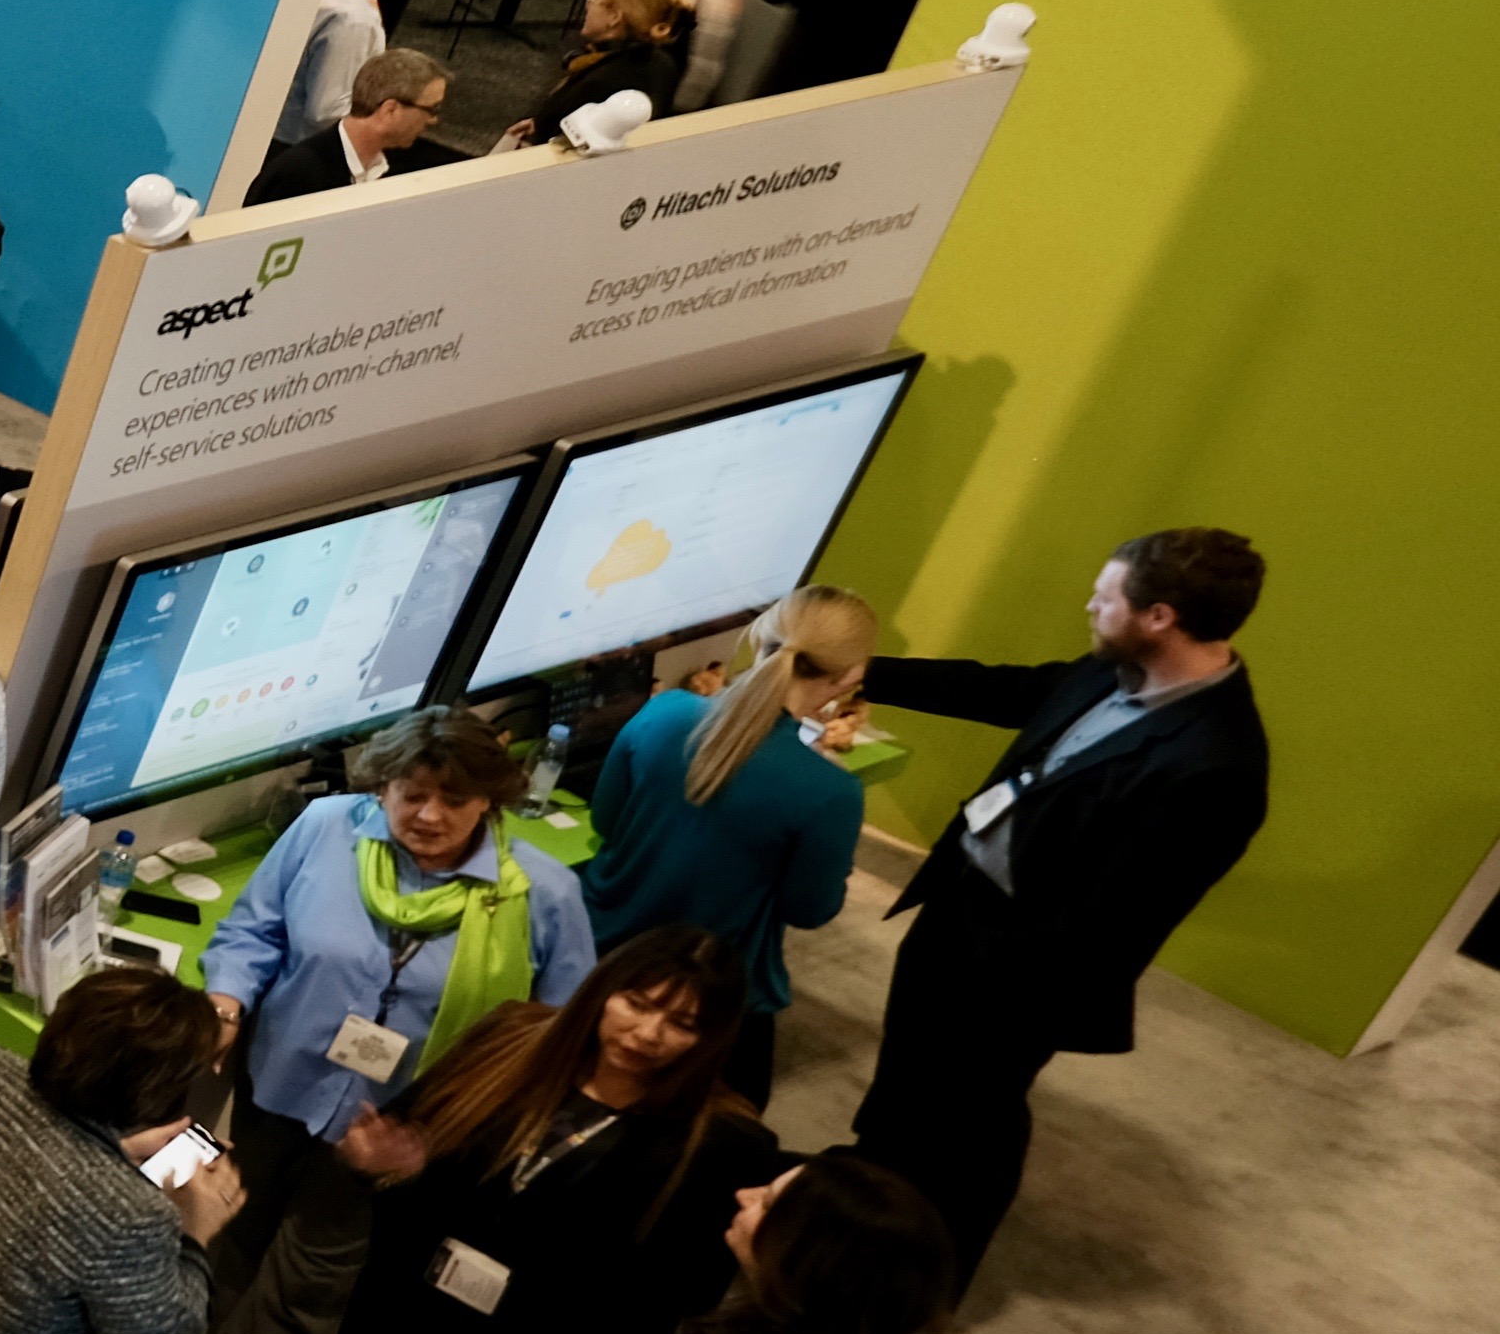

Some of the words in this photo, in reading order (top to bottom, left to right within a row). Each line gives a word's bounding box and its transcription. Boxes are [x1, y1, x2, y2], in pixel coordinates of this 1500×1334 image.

[652, 180, 735, 220] Hitachi
[736, 161, 842, 201] Solutions
[586, 267, 680, 306] Engaging
[680, 245, 758, 288] patients
[762, 235, 802, 261] with
[805, 203, 920, 252] on-demand
[138, 357, 235, 396] Creating
[238, 332, 363, 374] remarkable
[365, 305, 445, 349] patient
[157, 288, 254, 339] aspect
